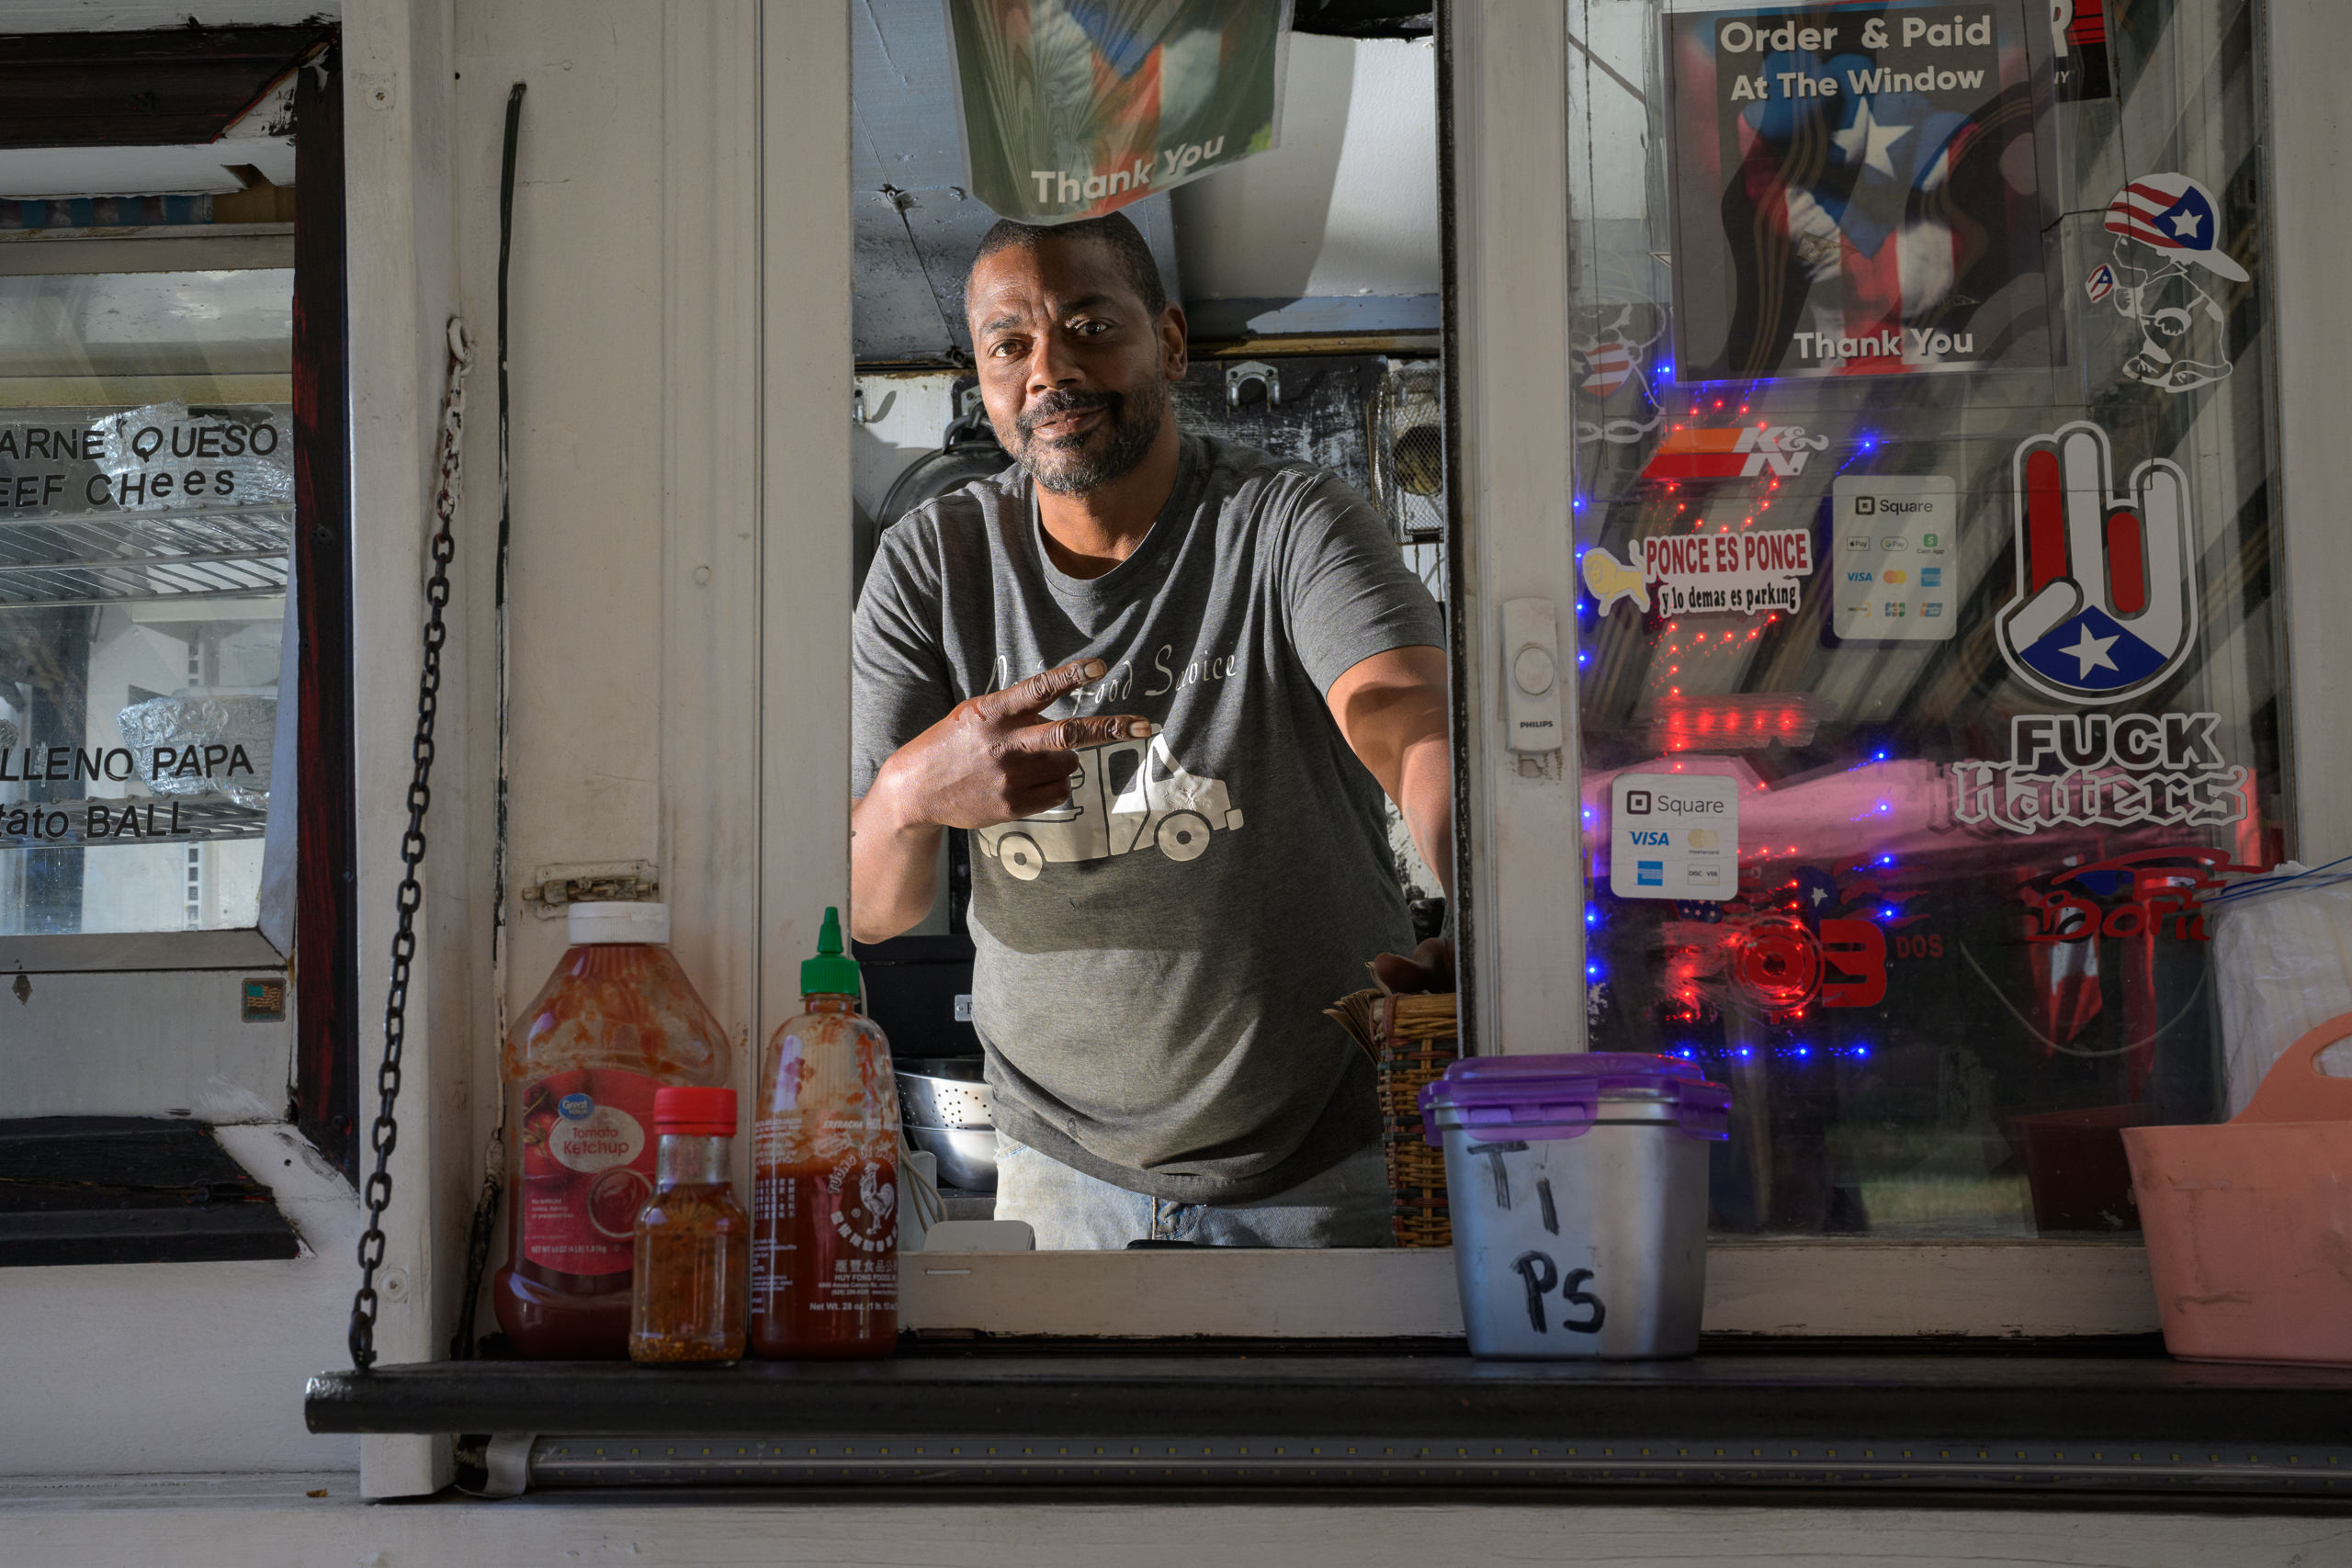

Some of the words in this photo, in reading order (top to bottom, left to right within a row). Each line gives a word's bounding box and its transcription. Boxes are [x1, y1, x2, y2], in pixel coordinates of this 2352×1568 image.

[1720, 20, 1838, 53] Order
[1860, 17, 1889, 49] &
[1903, 15, 1991, 48] Paid
[1730, 74, 1768, 100] At
[1776, 72, 1838, 97] The
[1847, 66, 1985, 95] Window
[1031, 159, 1154, 203] Thank
[1163, 135, 1225, 174] You
[1793, 329, 1903, 359] Thank
[1909, 327, 1973, 355] You
[132, 423, 277, 463] QUESO
[85, 469, 235, 506] CHees
[1880, 500, 1934, 515] Square
[1646, 536, 1710, 575] PONCE
[1715, 536, 1739, 572] ES
[1745, 533, 1808, 571] PONCE
[1847, 572, 1873, 581] VISA
[1661, 592, 1669, 615] y
[1672, 586, 1685, 609] lo
[1688, 585, 1726, 608] demas
[1730, 589, 1743, 607] es
[1747, 581, 1797, 610] parking
[1520, 720, 1554, 729] PHILIPS
[2011, 712, 2225, 771] FUCK
[152, 743, 255, 781] PAPA
[1657, 795, 1724, 817] Square
[1952, 760, 2248, 835] Haters
[85, 801, 191, 839] BALL
[1629, 830, 1669, 846] VISA
[1896, 934, 1944, 958] DOS
[563, 1140, 630, 1156] Ketchup
[573, 1126, 619, 1139] Tomato
[808, 1302, 824, 1312] Net
[842, 1302, 853, 1312] 28
